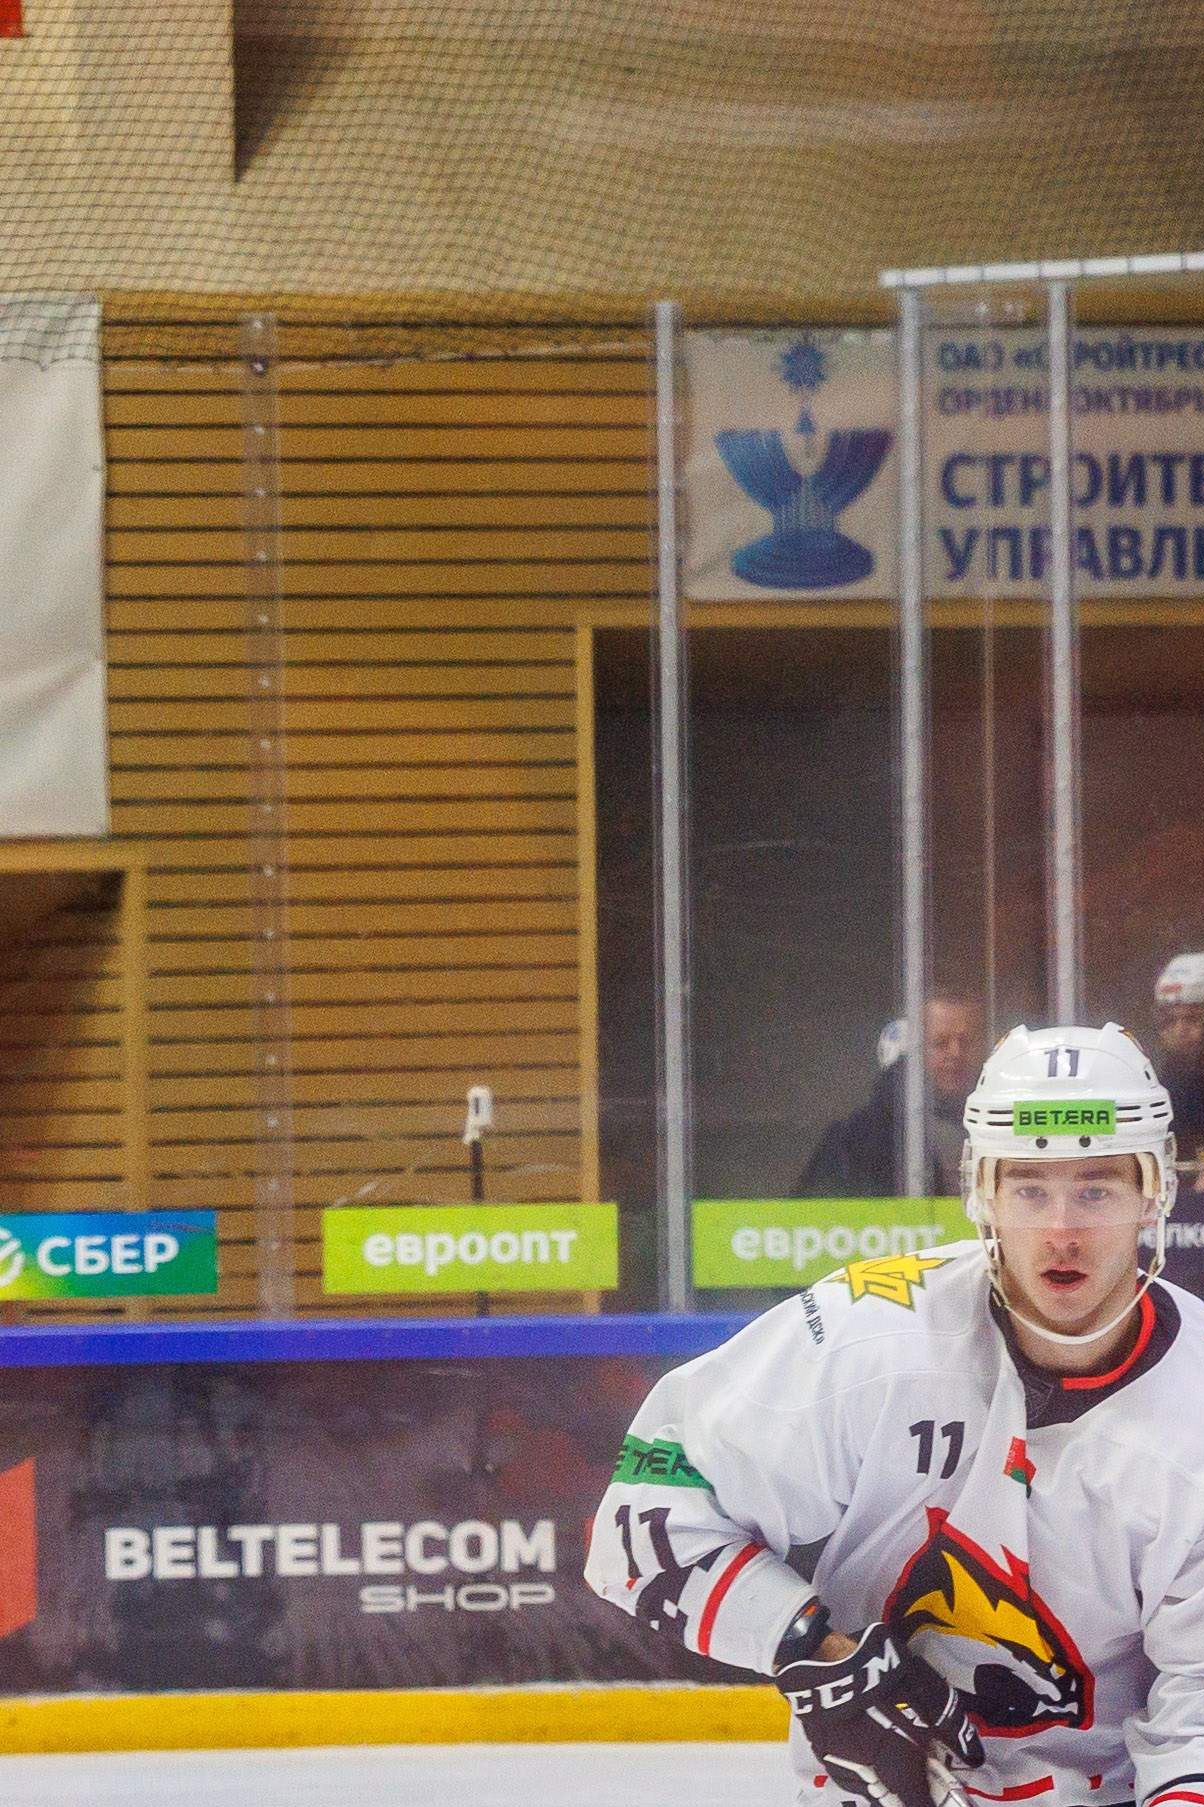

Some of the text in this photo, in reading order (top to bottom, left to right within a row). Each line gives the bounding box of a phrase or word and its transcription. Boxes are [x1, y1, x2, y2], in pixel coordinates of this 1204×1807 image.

[1044, 1048, 1081, 1078] 11
[1018, 1109, 1110, 1127] BETERA
[37, 1232, 180, 1277] СБЕР
[362, 1229, 578, 1277] евроопт
[731, 1223, 944, 1271] евроопт
[908, 1419, 966, 1480] 11
[104, 1519, 556, 1581] BELTELECOM
[359, 1582, 556, 1614] SHOP
[783, 1637, 901, 1716] CCM
